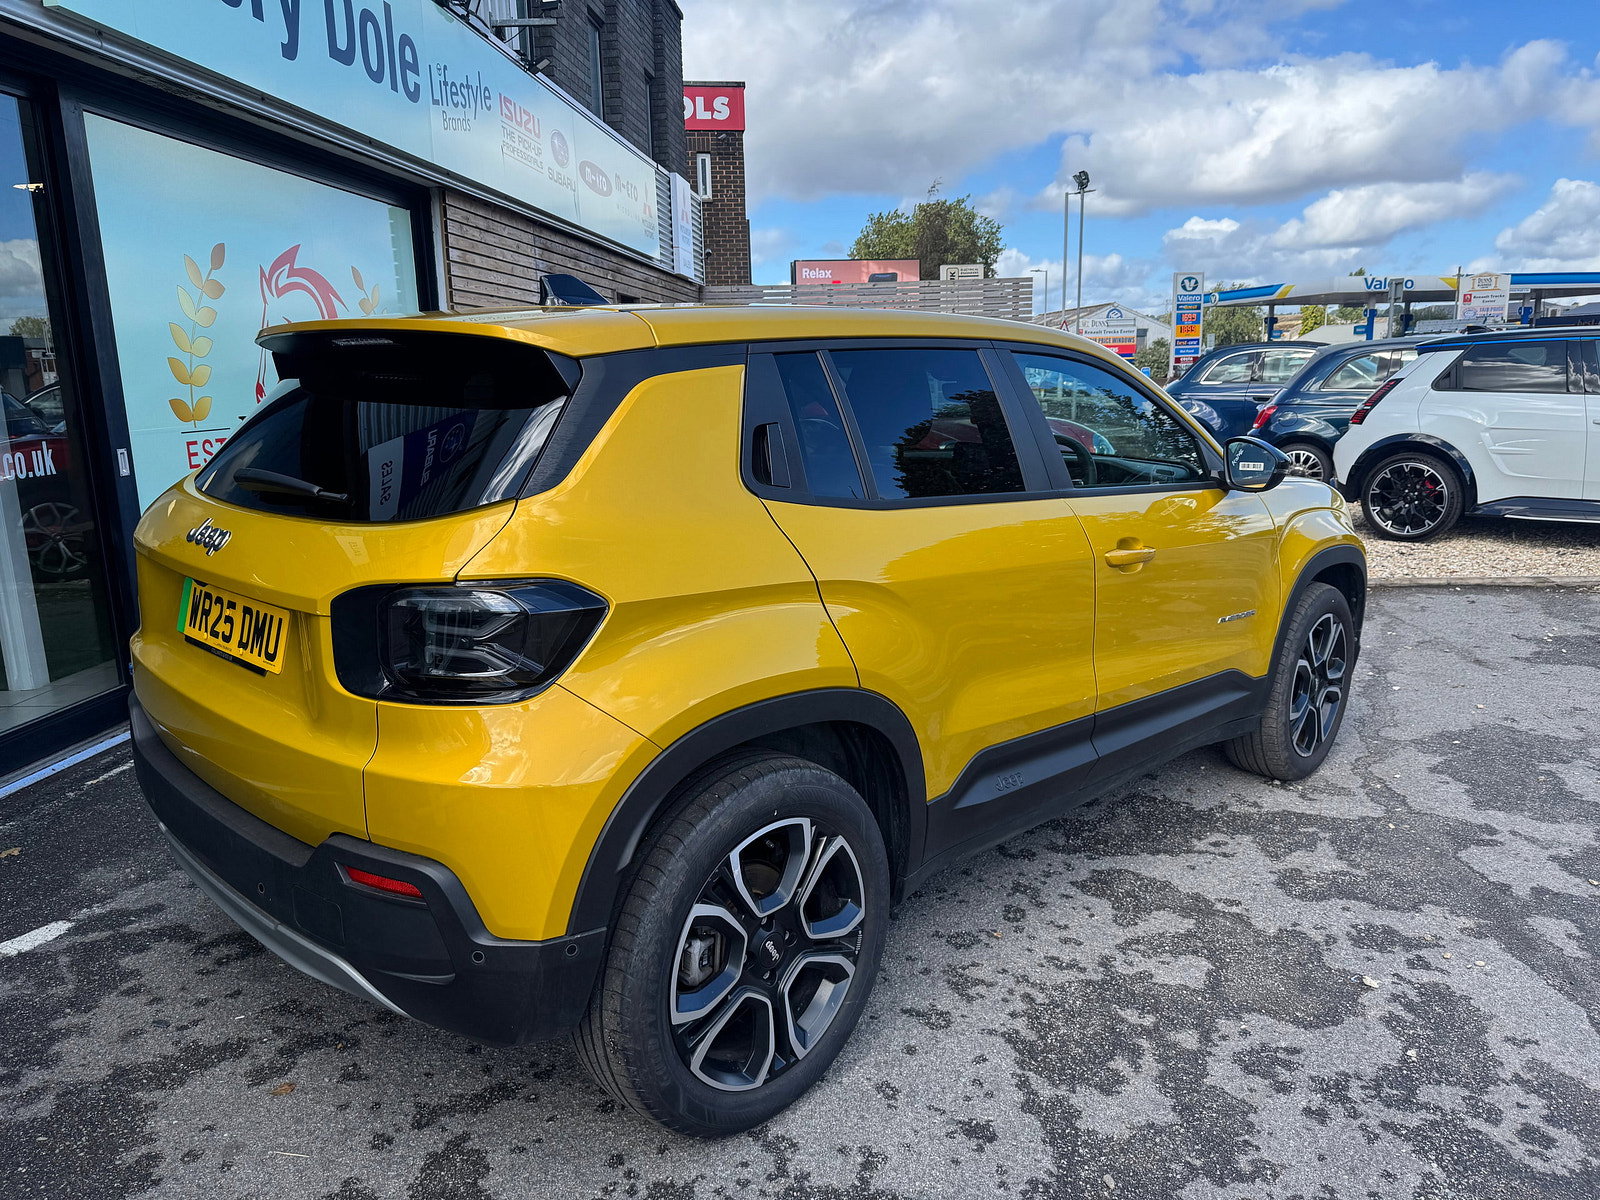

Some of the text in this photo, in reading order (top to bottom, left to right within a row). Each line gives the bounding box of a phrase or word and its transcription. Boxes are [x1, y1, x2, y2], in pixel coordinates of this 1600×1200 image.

[324, 0, 421, 104] Dole
[428, 63, 492, 120] Lifestyle
[441, 110, 471, 132] Brands
[499, 92, 541, 139] ISUZU
[501, 125, 516, 144] THE
[547, 166, 576, 193] SUBARU
[802, 268, 832, 279] Relax
[1364, 277, 1414, 290] Valo
[186, 517, 232, 557] Jeep
[188, 586, 283, 663] WR25 DMU
[995, 771, 1024, 792] Jeep
[765, 940, 780, 961] Jeep
